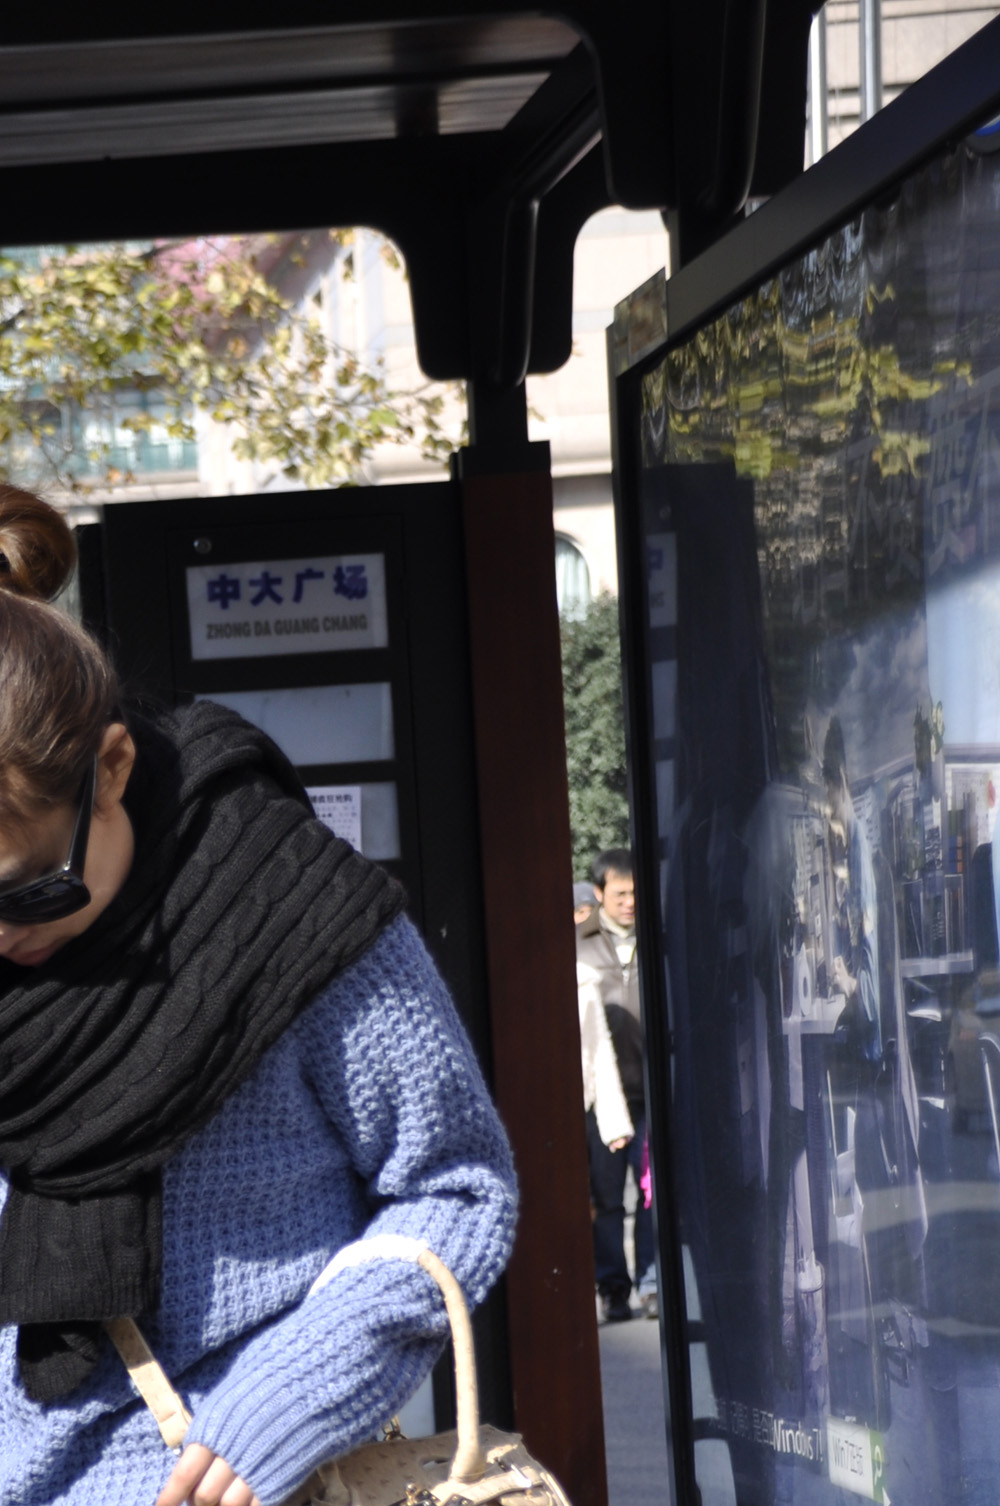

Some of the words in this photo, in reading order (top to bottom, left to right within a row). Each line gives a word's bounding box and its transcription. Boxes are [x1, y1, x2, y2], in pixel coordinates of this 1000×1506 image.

[207, 565, 368, 610] 中大广场
[206, 619, 250, 640] ZHONG
[254, 620, 272, 637] DA
[274, 616, 320, 636] GUANG
[322, 614, 368, 632] CHANG
